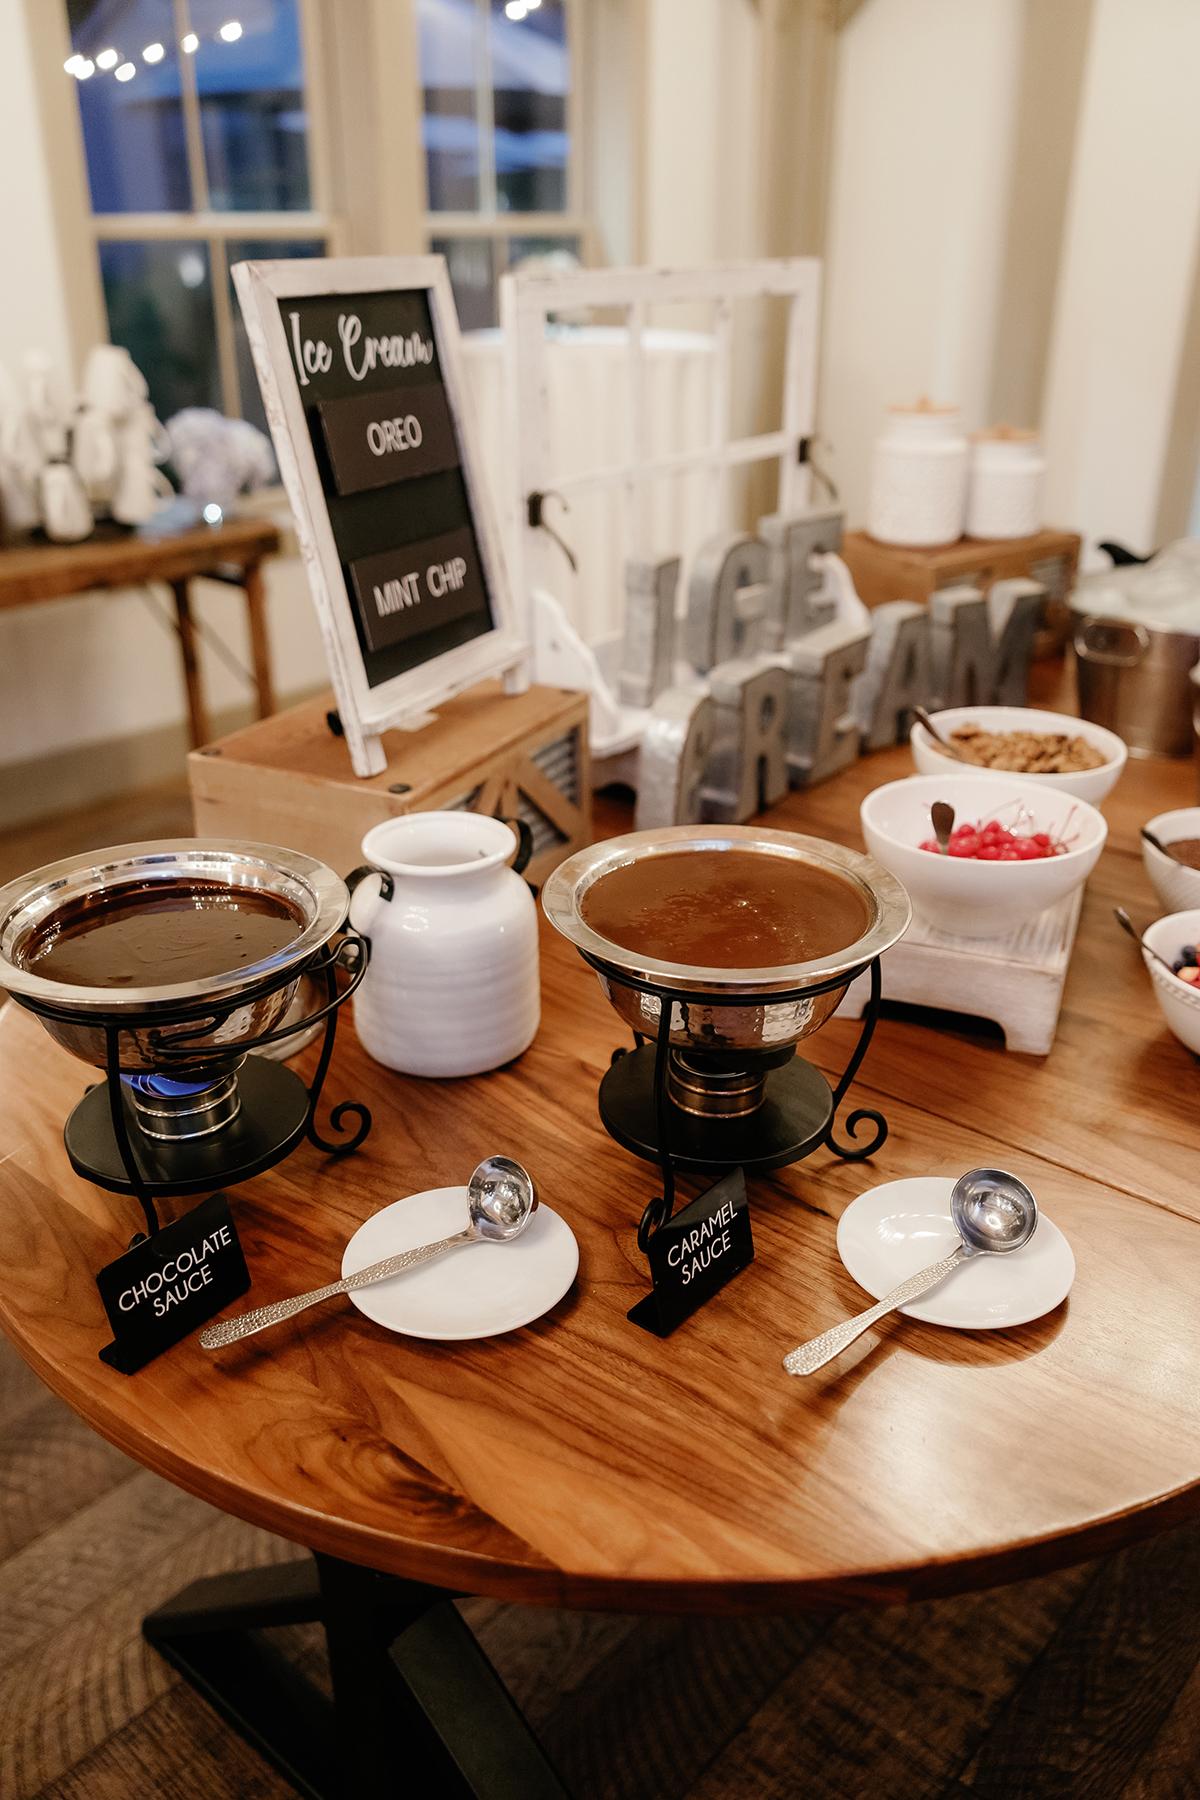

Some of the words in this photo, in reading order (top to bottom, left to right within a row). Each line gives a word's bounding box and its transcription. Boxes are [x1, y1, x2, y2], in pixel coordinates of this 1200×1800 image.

[289, 312, 332, 386] Ice
[338, 314, 433, 381] Cream
[367, 415, 422, 456] OREO
[373, 572, 421, 616] MINT
[427, 557, 467, 598] CHIP
[623, 508, 846, 708] ICE
[667, 1200, 738, 1267] CARAMEL
[681, 1229, 731, 1285] SAUCE
[118, 1225, 232, 1311] CHOCOLATE
[153, 1264, 213, 1317] SAUCE
